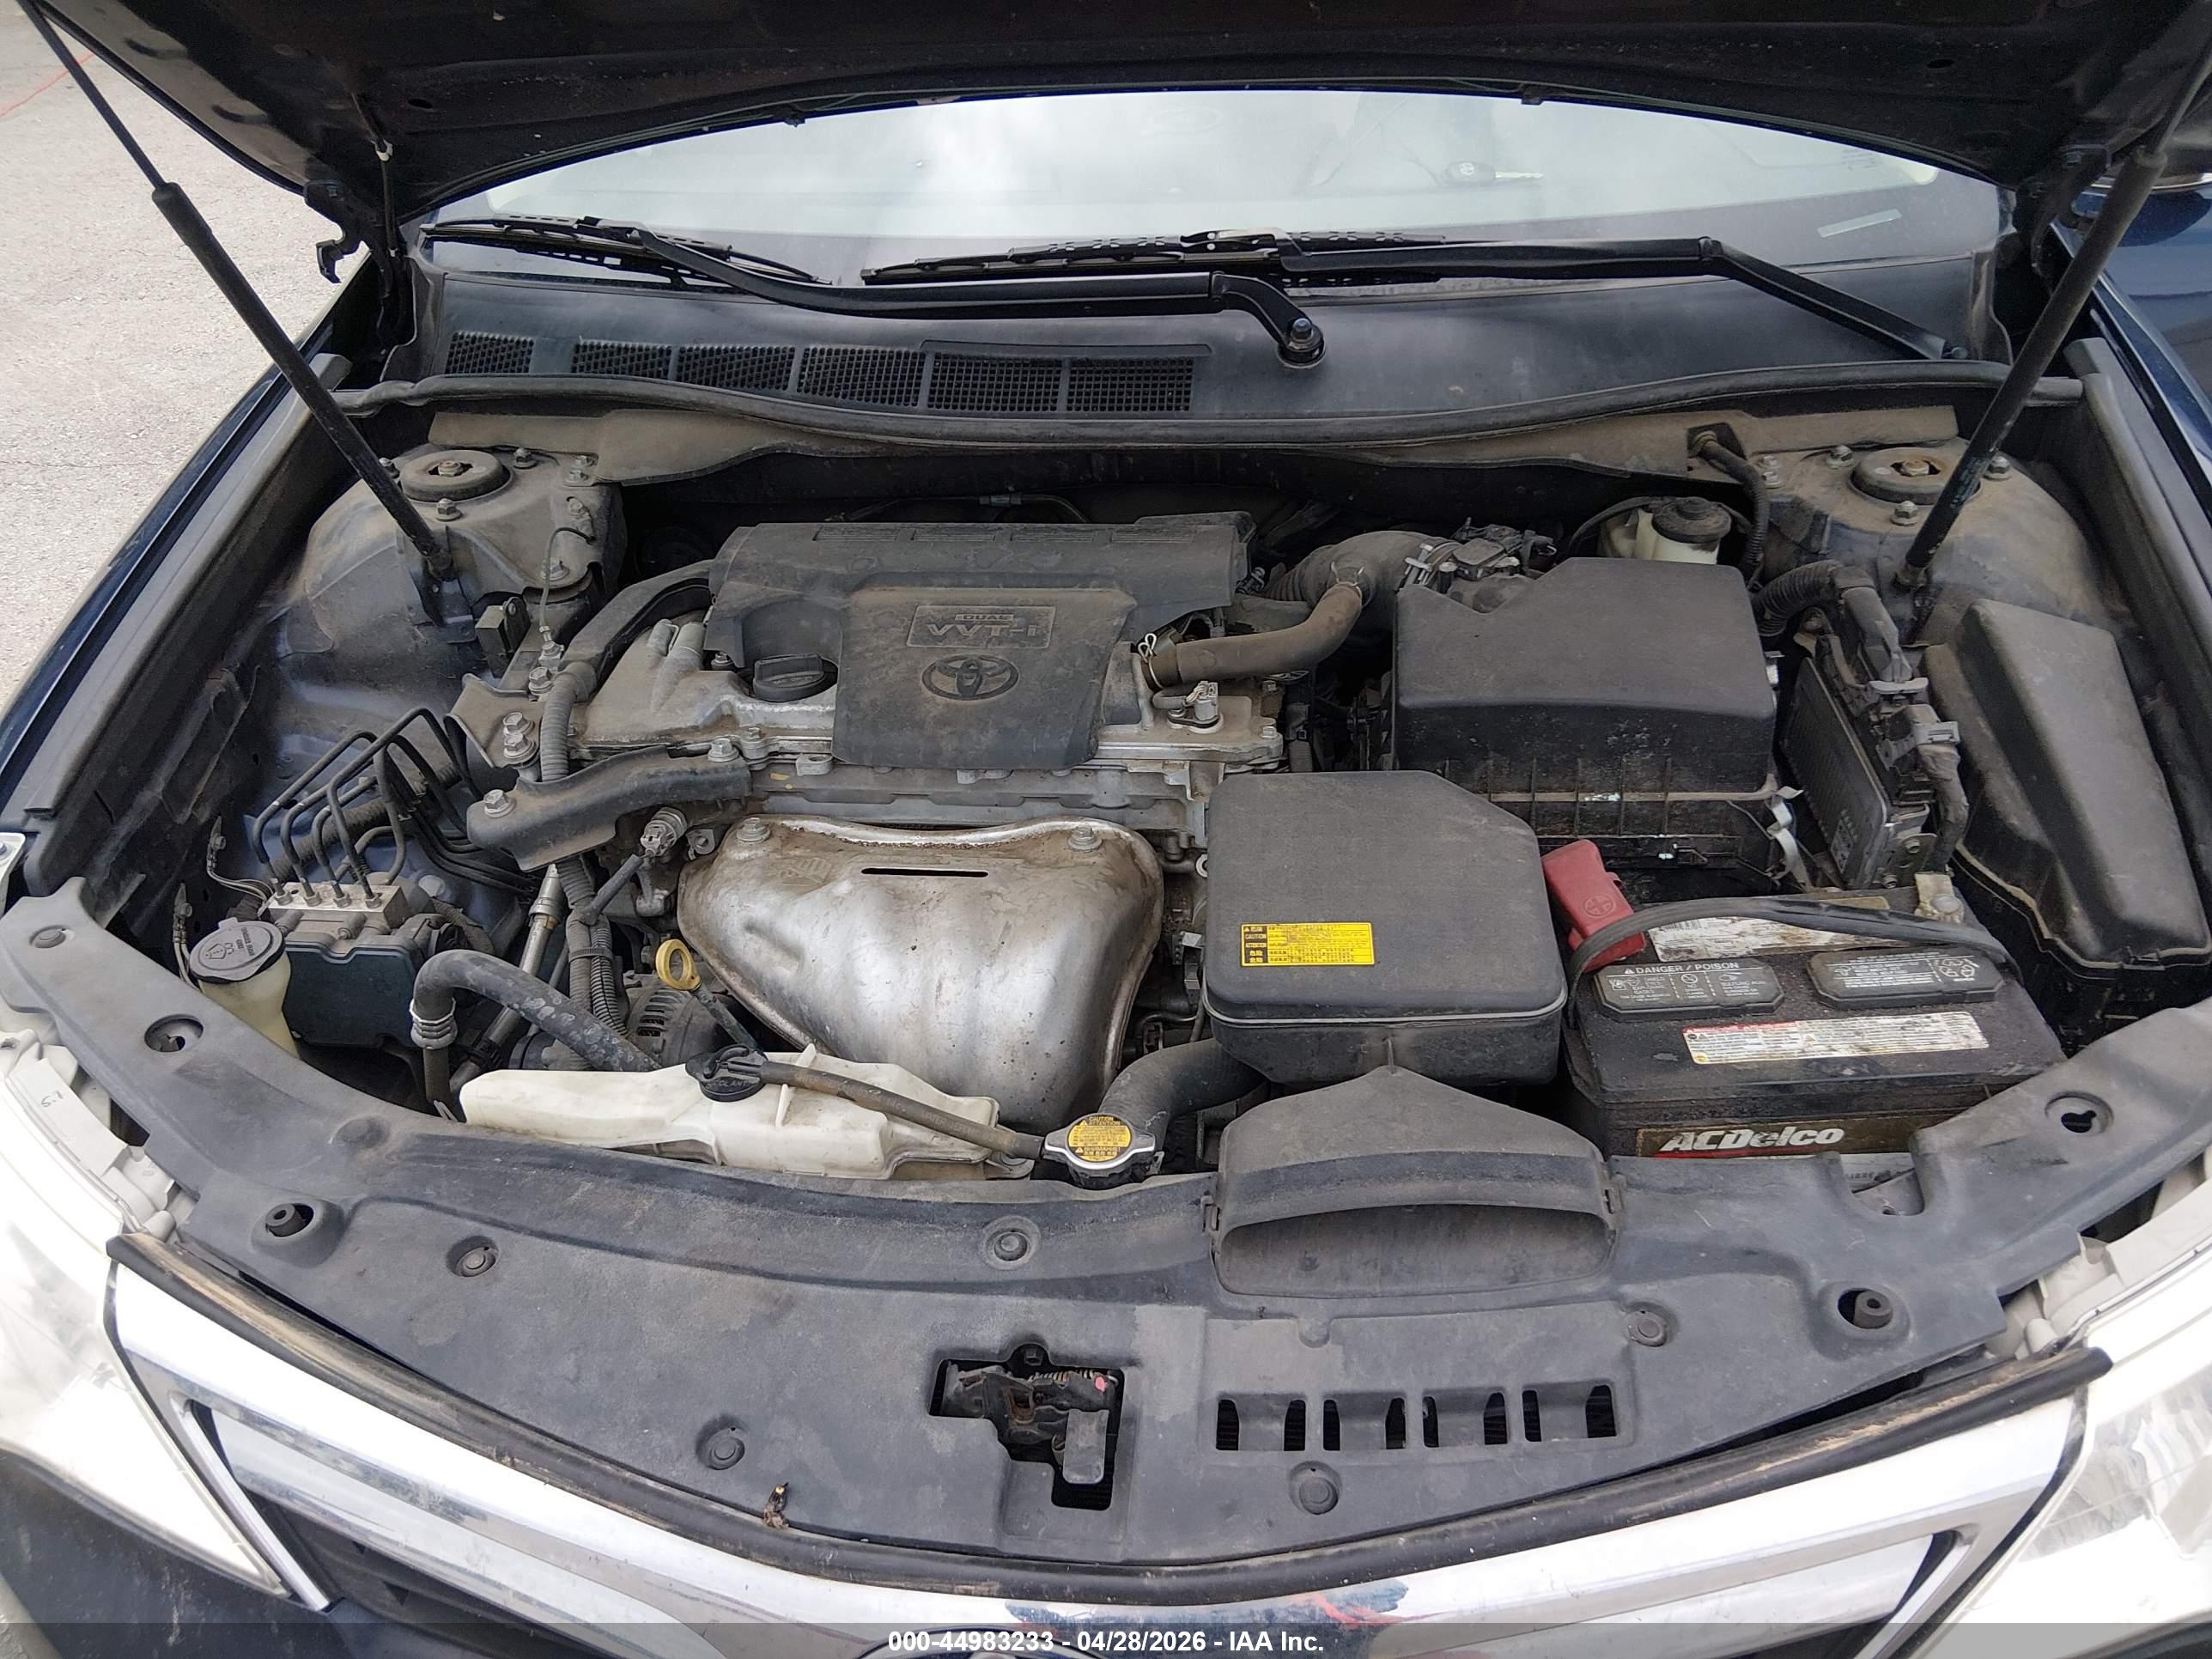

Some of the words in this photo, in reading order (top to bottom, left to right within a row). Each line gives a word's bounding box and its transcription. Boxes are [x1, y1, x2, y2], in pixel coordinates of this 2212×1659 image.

[927, 623, 1037, 637] VVT-i
[1635, 964, 1684, 974] DANGER
[1694, 962, 1740, 970] POISON
[1660, 1126, 1845, 1152] ACDelco
